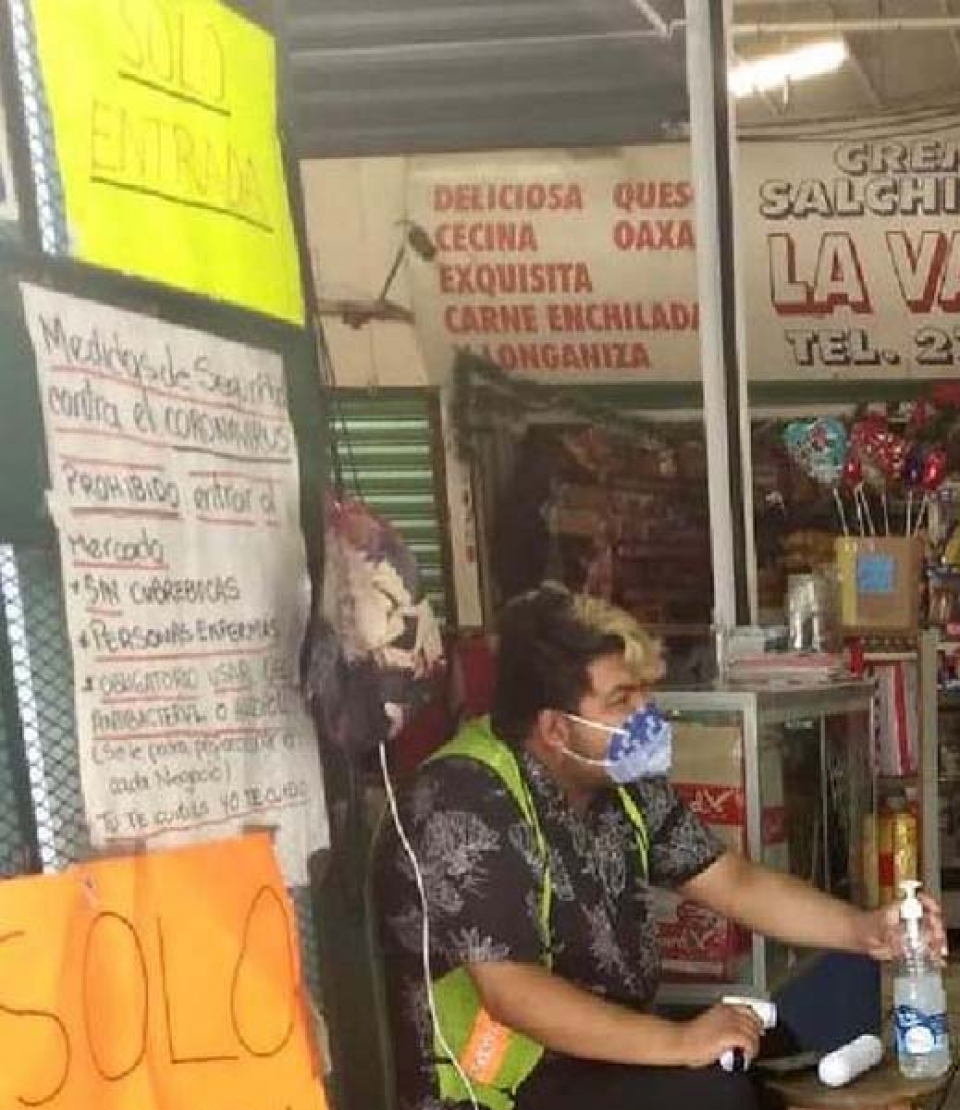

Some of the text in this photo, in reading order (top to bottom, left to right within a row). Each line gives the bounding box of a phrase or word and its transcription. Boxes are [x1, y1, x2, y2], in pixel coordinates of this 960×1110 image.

[433, 183, 583, 212] DELICIOSA
[613, 181, 695, 213] QUES
[434, 221, 538, 252] CECINA
[613, 220, 697, 250] OAXA
[439, 262, 593, 296] EXQUISITA
[767, 232, 873, 318] LA
[444, 305, 538, 333] CARNE
[786, 328, 901, 367] TEL.
[48, 379, 122, 429] contra
[134, 387, 158, 434] el
[62, 464, 180, 508] PROHIBIDO
[193, 472, 253, 511] entrar
[67, 527, 164, 561] Mercado
[84, 574, 120, 605] SIN
[0, 885, 296, 1107] SOLO
